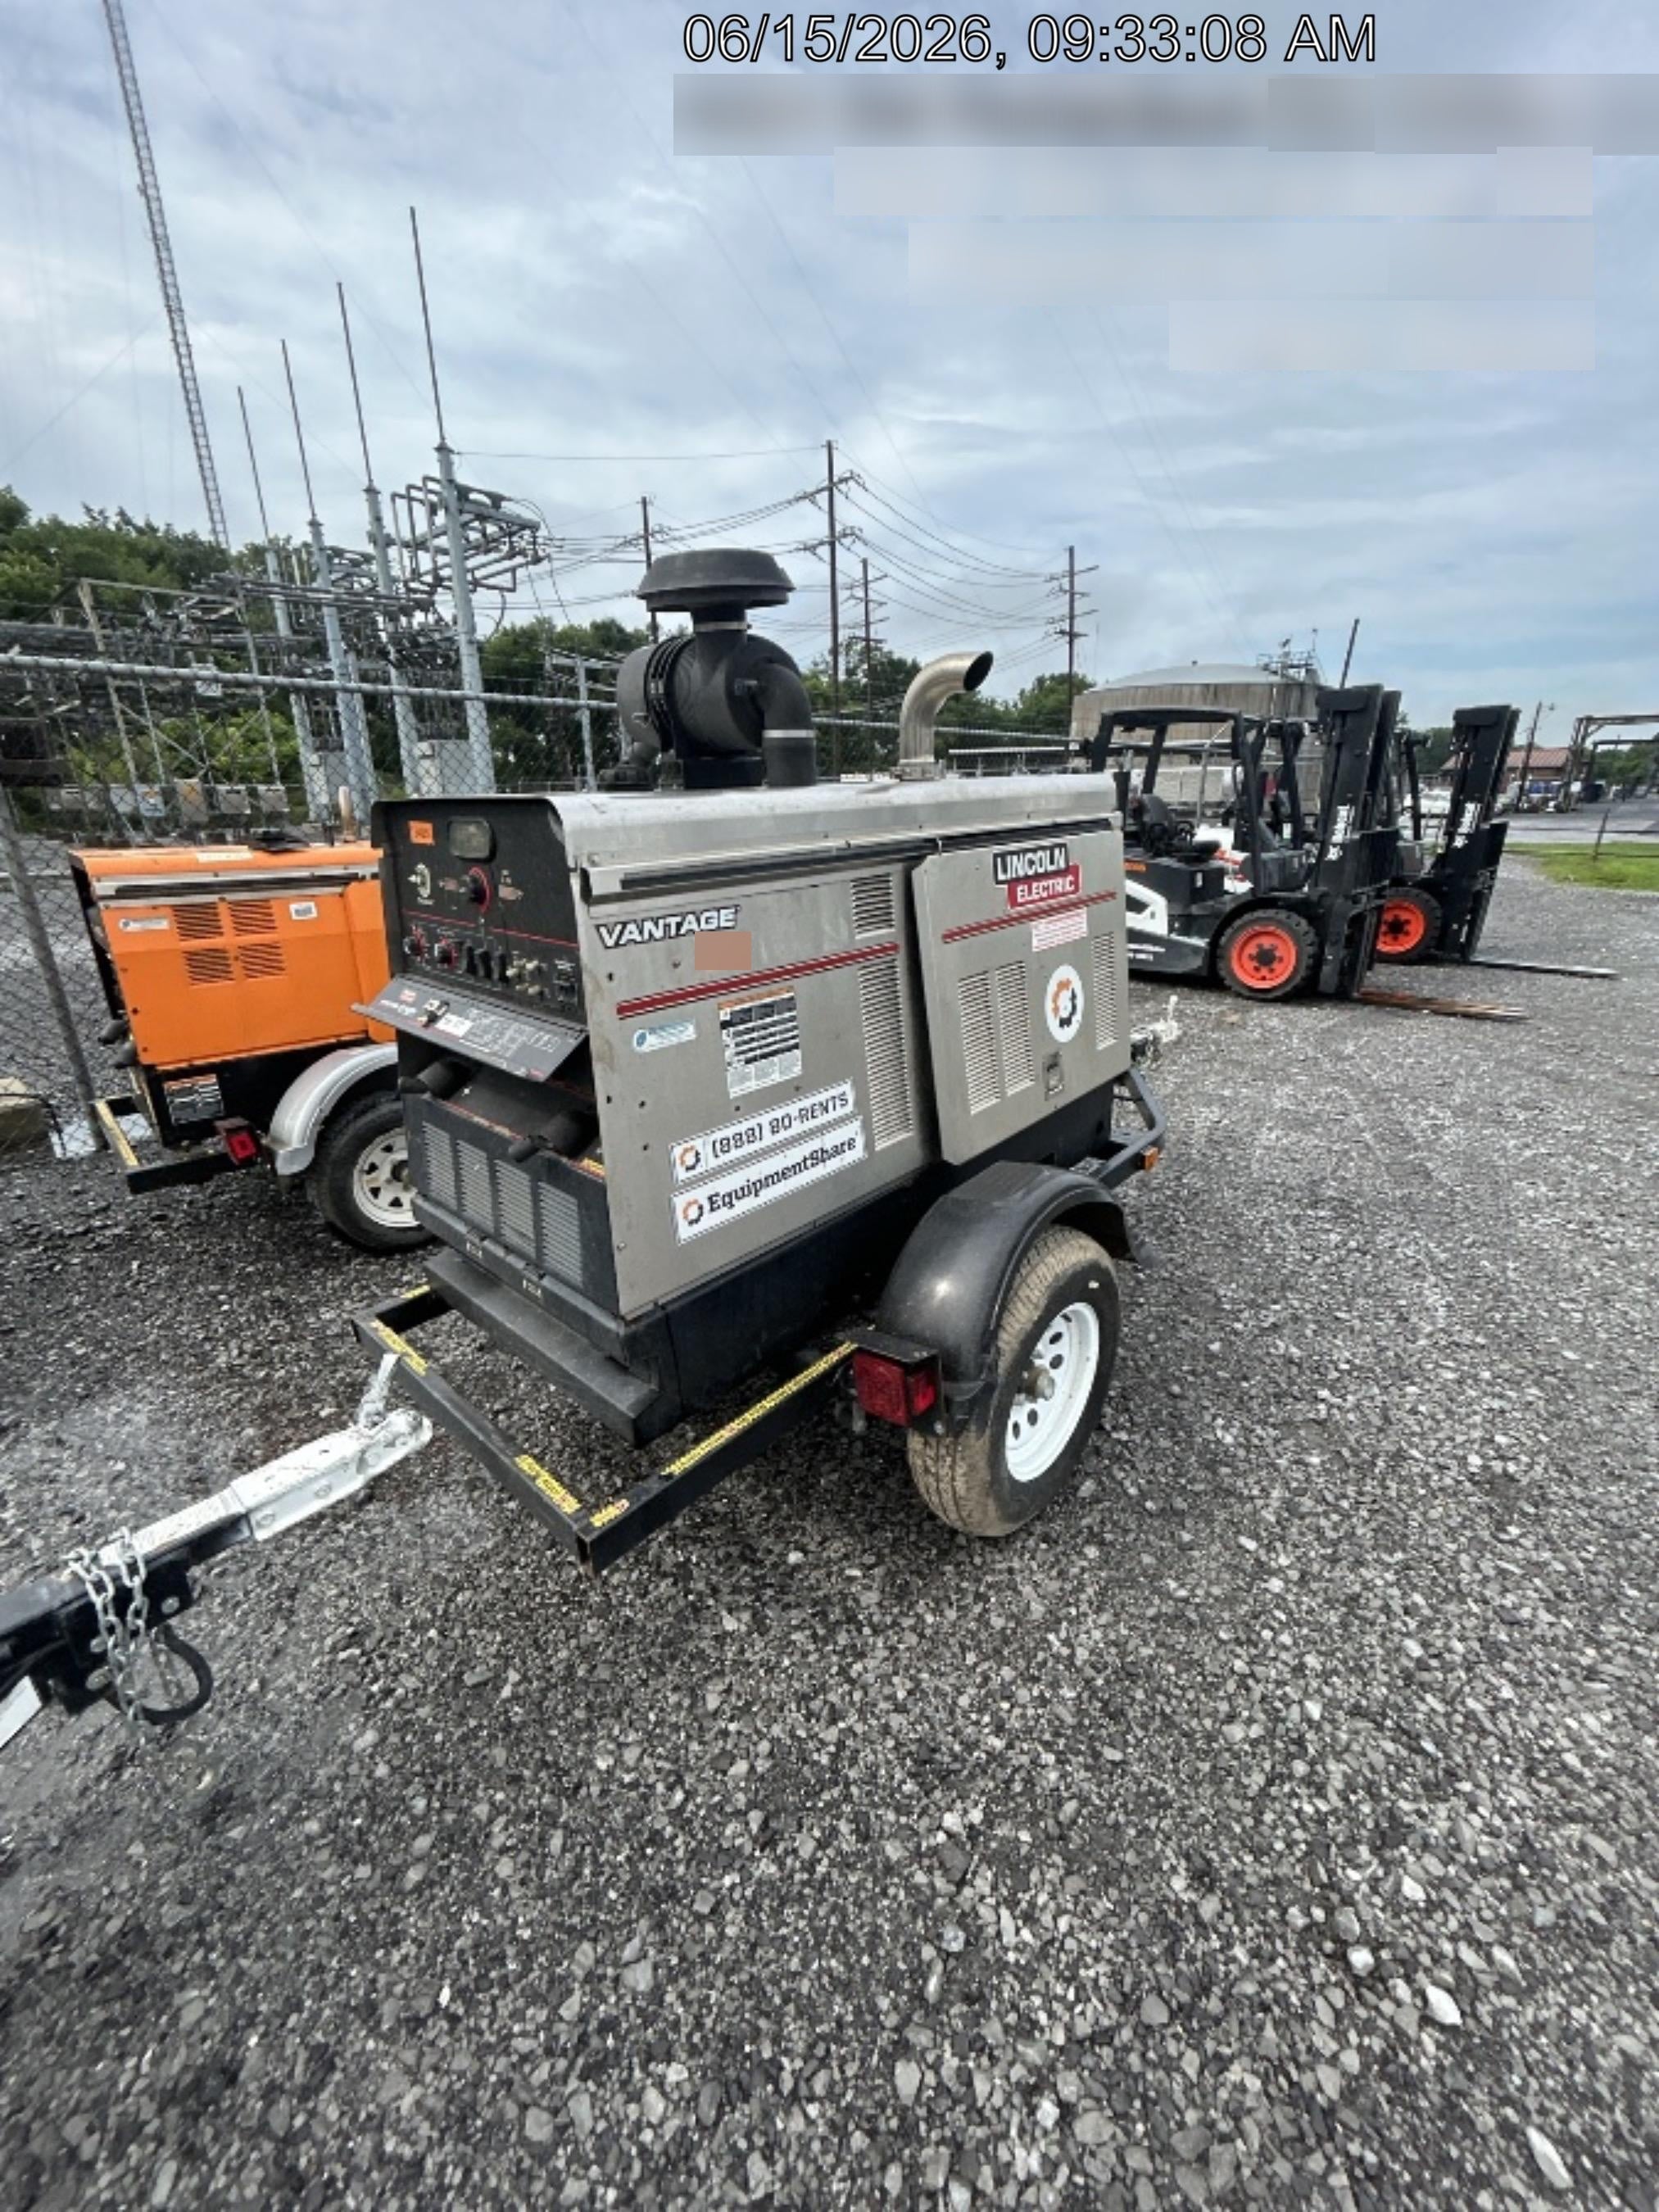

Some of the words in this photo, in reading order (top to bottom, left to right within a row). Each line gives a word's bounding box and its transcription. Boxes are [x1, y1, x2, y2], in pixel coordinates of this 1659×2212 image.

[995, 846, 1067, 882] LINCOLN
[1016, 874, 1076, 904] ELECTRIC
[596, 905, 738, 949] VANTAGE
[711, 1123, 764, 1158] (888)
[768, 1090, 850, 1136] 80-RENTS
[706, 1135, 858, 1213] EquipmentShare
